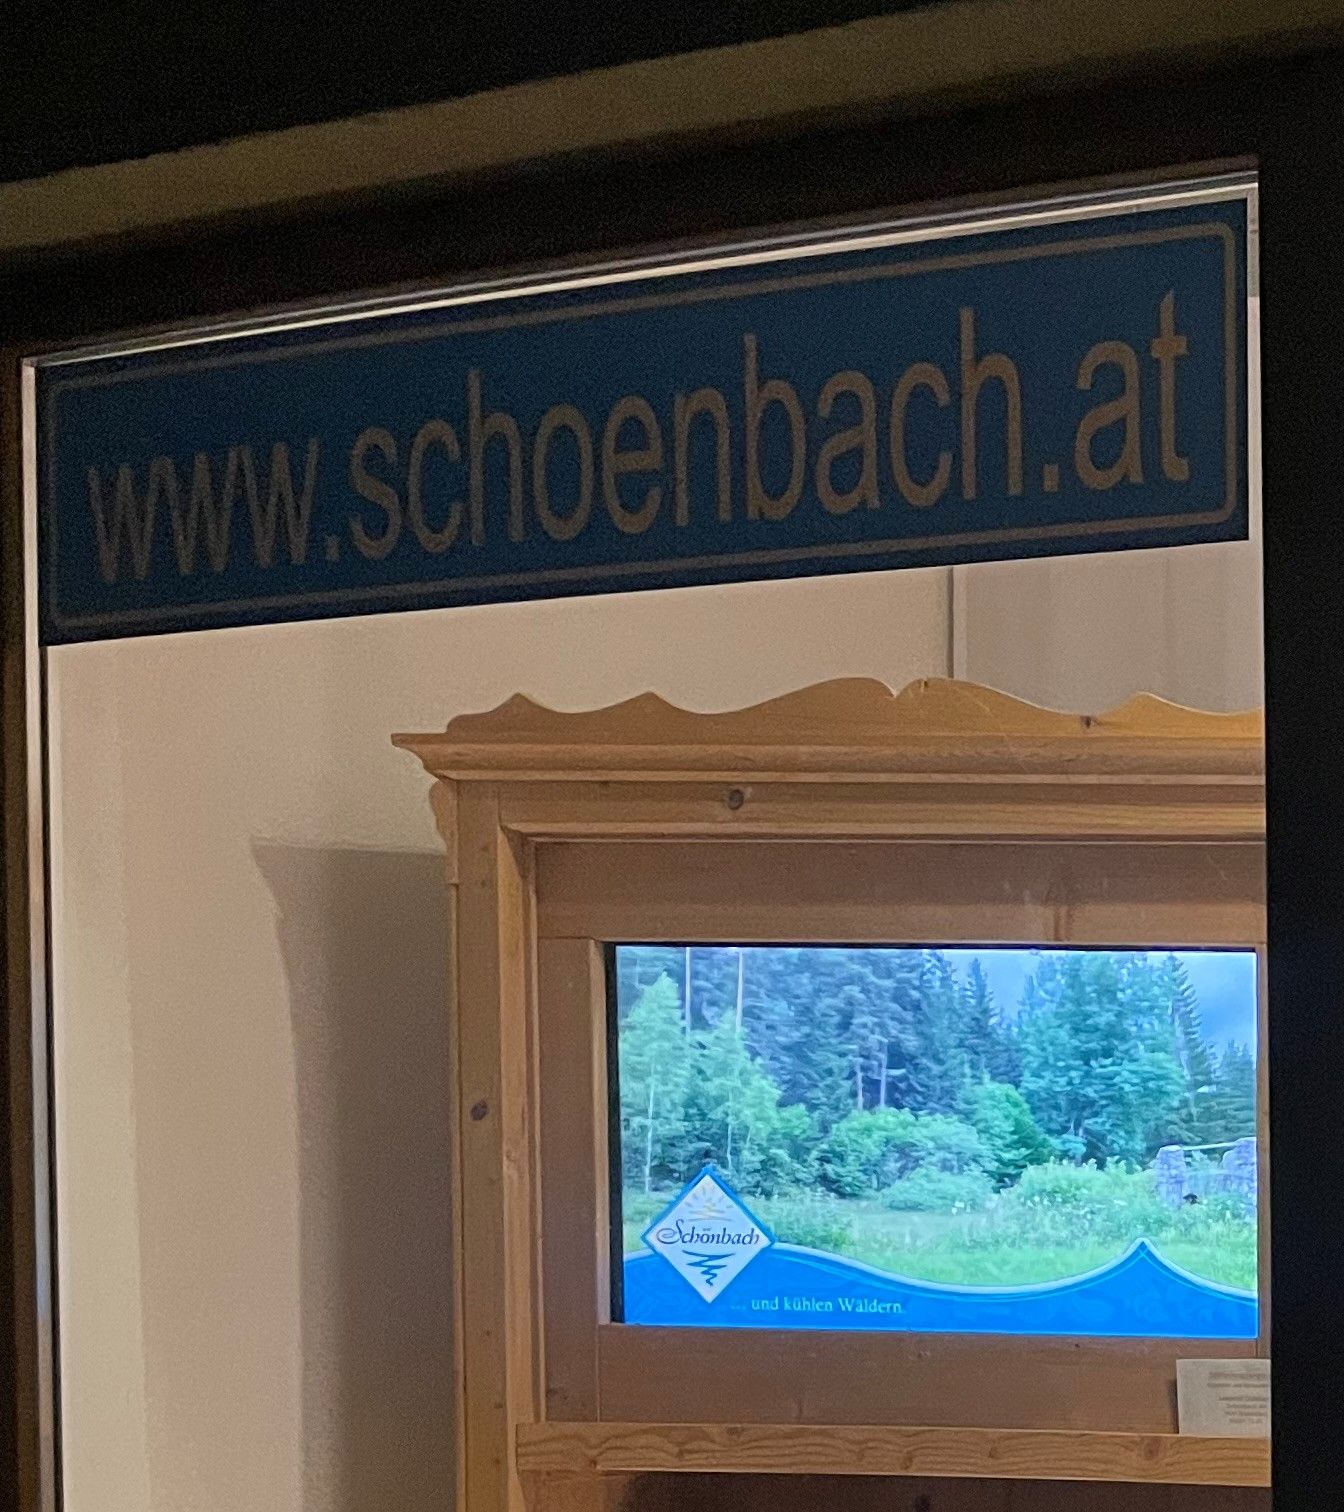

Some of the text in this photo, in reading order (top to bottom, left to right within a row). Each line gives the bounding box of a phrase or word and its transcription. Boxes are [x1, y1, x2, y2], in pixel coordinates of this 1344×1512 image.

[86, 289, 1190, 583] www.schoenbach.at
[656, 1218, 761, 1246] Schönbach
[751, 1297, 779, 1311] und
[783, 1296, 833, 1312] kühlen
